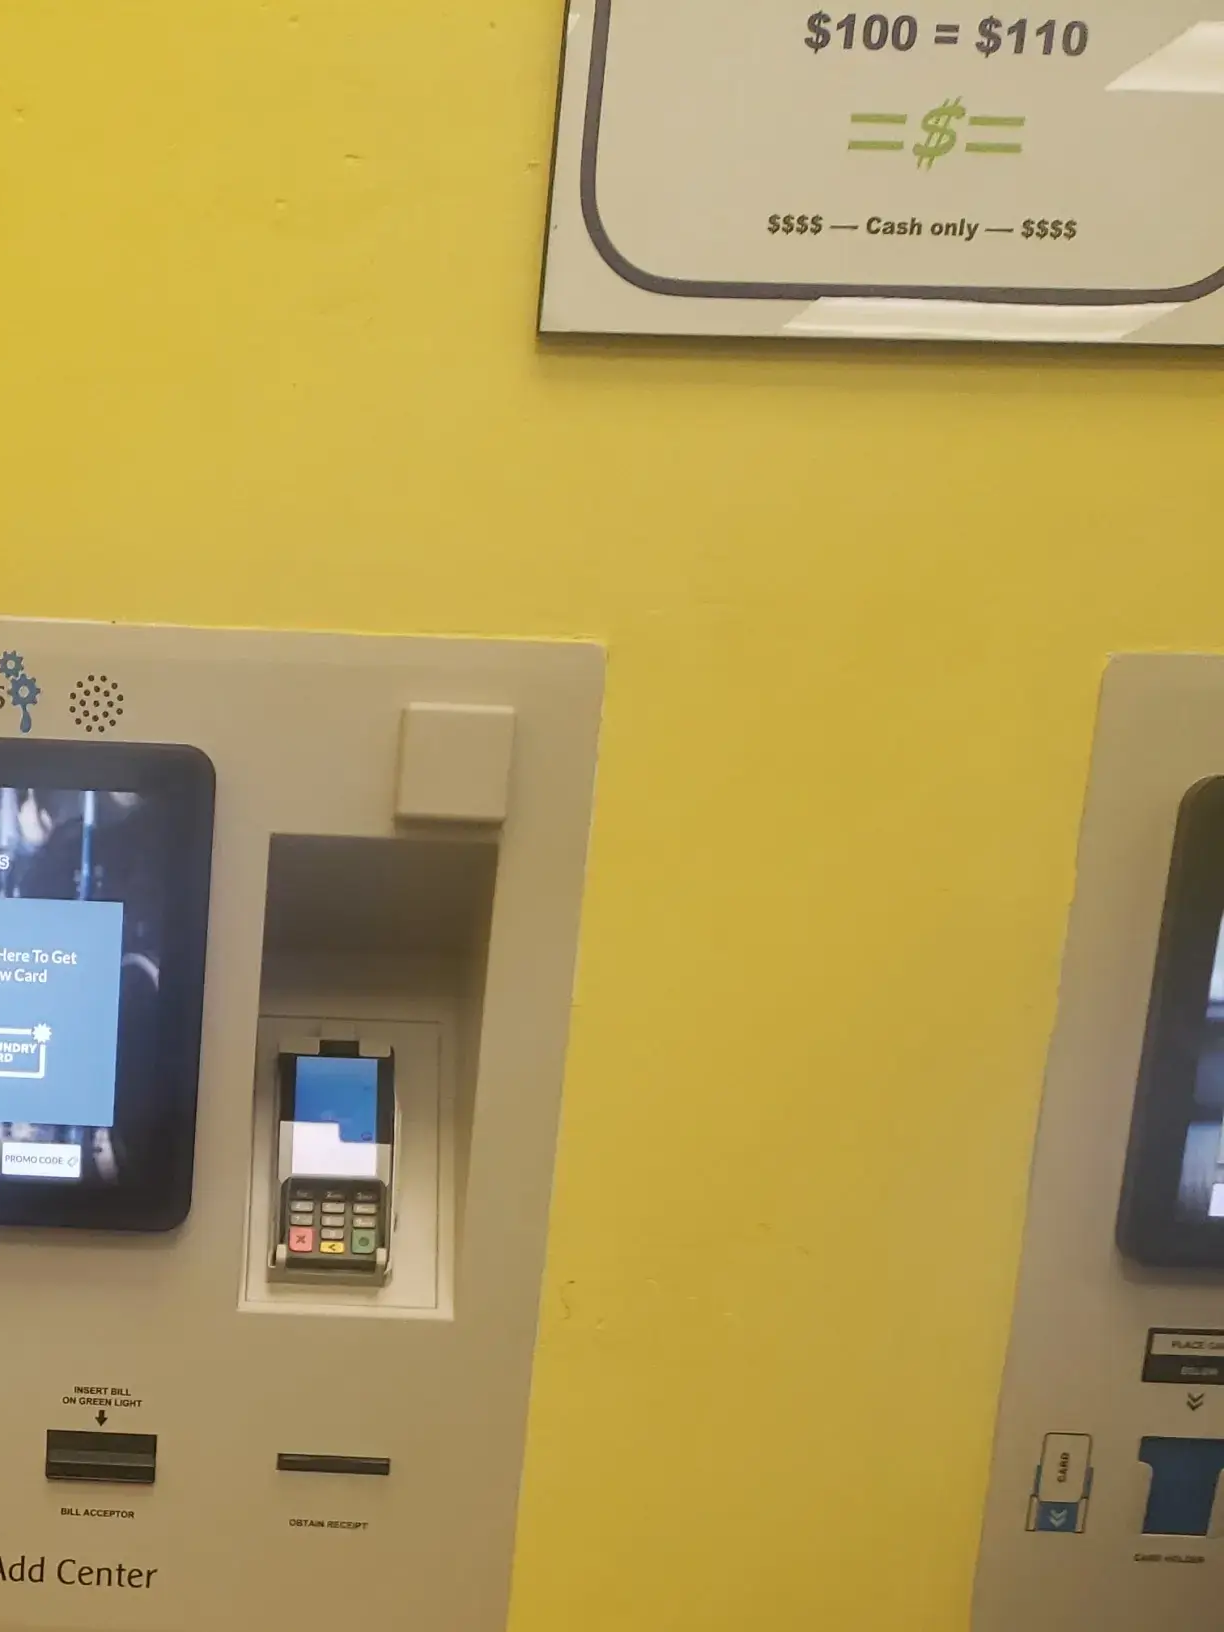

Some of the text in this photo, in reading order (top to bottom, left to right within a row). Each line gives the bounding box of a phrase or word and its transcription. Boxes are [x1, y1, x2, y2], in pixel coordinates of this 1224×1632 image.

[804, 11, 918, 54] $100
[975, 15, 1090, 58] $110
[767, 213, 824, 238] $$$$
[865, 215, 923, 237] Cash
[930, 217, 980, 242] only
[1020, 217, 1078, 241] $$$$
[32, 949, 49, 964] To
[51, 950, 78, 965] Get
[14, 968, 48, 983] Card
[5, 1154, 64, 1165] PROMO CODE
[74, 1386, 131, 1397] INSERT BILL
[62, 1396, 142, 1409] ON GREEN LIGHT
[1057, 1452, 1070, 1483] CARD
[60, 1507, 135, 1519] BILL ACCEPTOR
[288, 1518, 369, 1531] OBTAIN RECEIPT
[56, 1558, 158, 1589] Center
